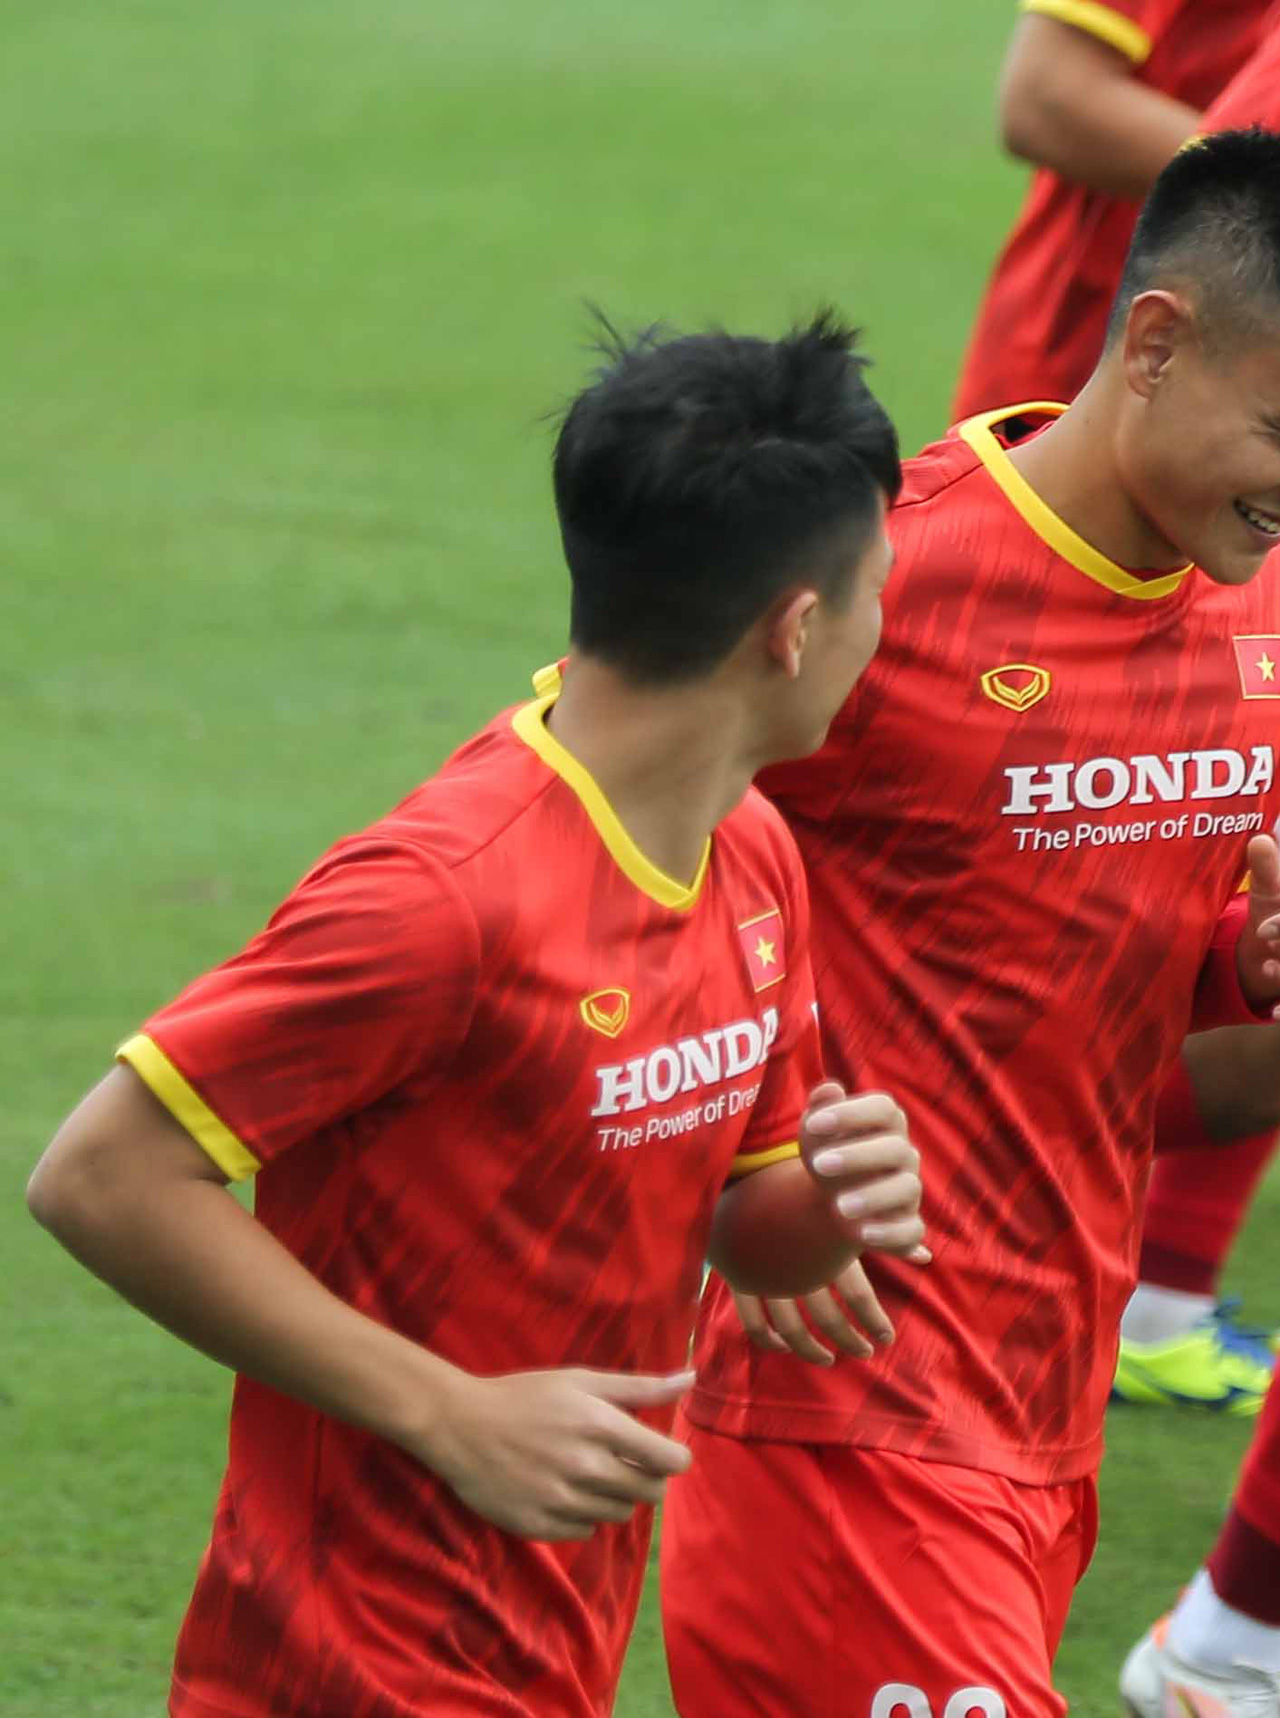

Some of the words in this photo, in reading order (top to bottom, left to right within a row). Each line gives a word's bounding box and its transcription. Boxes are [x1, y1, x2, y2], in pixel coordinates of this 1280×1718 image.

[1001, 745, 1274, 815] HONDA
[1012, 826, 1070, 852] The
[1074, 820, 1153, 849] Power
[1159, 813, 1189, 840] of
[591, 1007, 780, 1117] HONDA
[598, 1127, 642, 1151] The
[645, 1105, 703, 1143] Power
[704, 1094, 726, 1124] of
